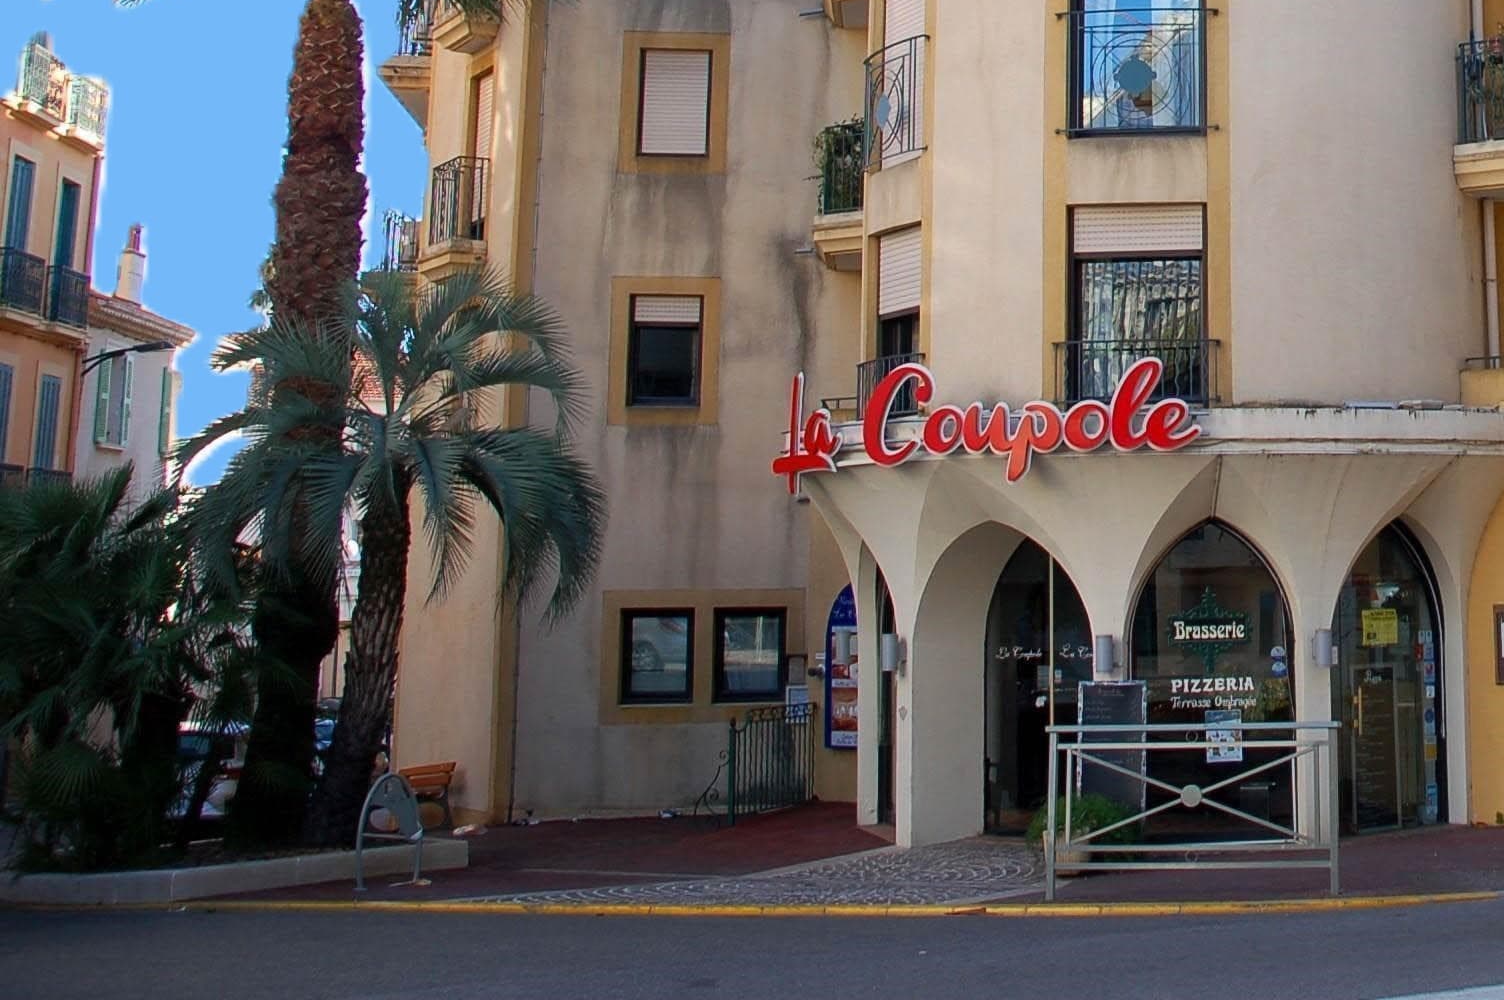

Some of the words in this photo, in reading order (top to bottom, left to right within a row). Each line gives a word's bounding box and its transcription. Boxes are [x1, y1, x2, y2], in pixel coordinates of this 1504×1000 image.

[772, 372, 843, 496] La
[863, 356, 1201, 484] Coupole
[1173, 619, 1245, 641] Brasserie
[1170, 676, 1255, 694] PIZZERIA
[1170, 695, 1211, 710] Terrasse
